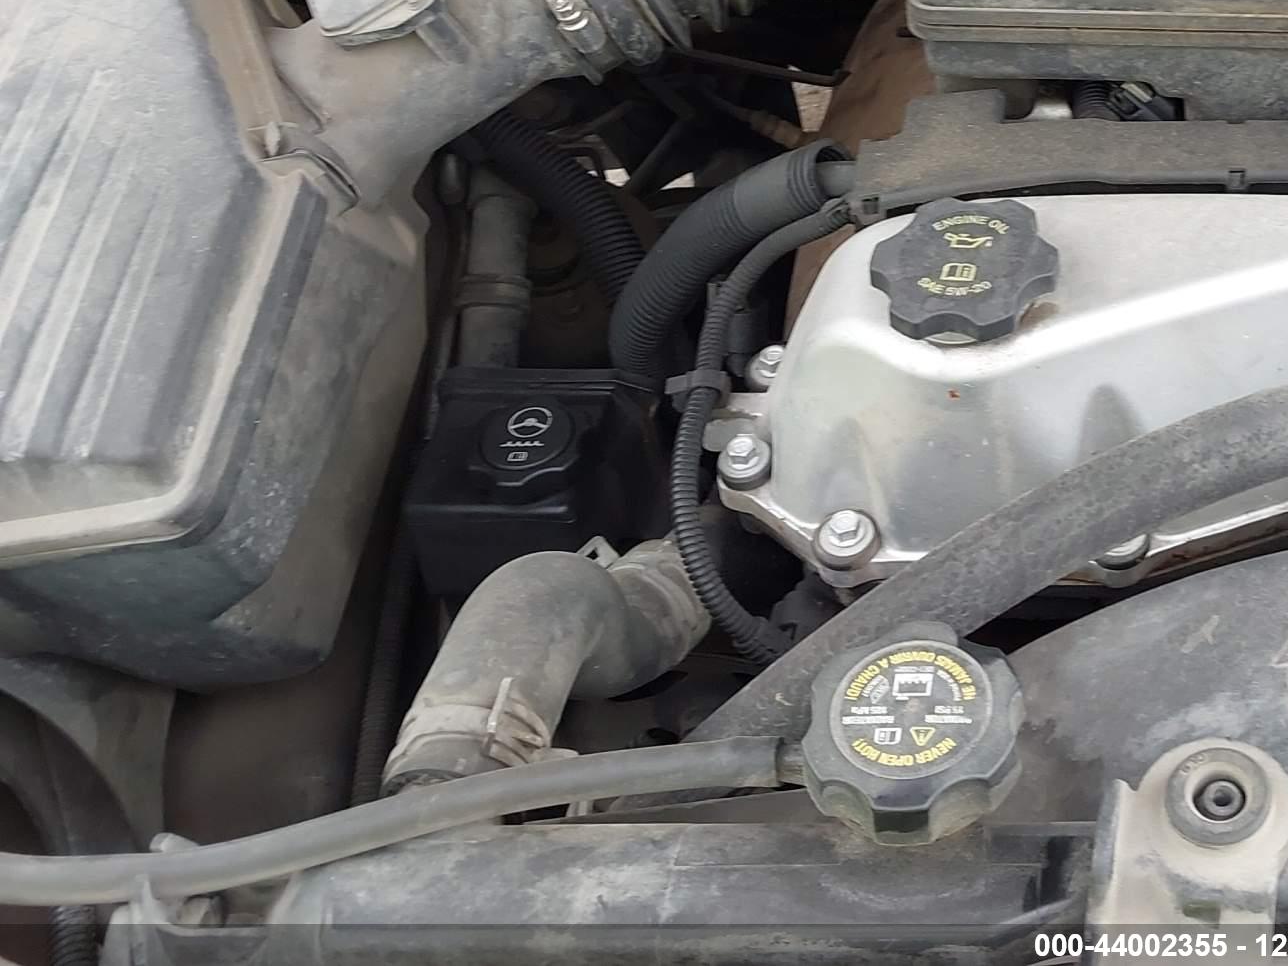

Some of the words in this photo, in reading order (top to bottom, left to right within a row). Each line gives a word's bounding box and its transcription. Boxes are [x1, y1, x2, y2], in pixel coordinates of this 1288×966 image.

[931, 215, 988, 231] ENGINE
[988, 219, 1010, 234] OIL
[917, 277, 944, 294] SAE
[961, 684, 977, 700] NE
[852, 738, 878, 761] HOT!
[915, 737, 957, 764] NEVER
[877, 752, 914, 766] OPEN
